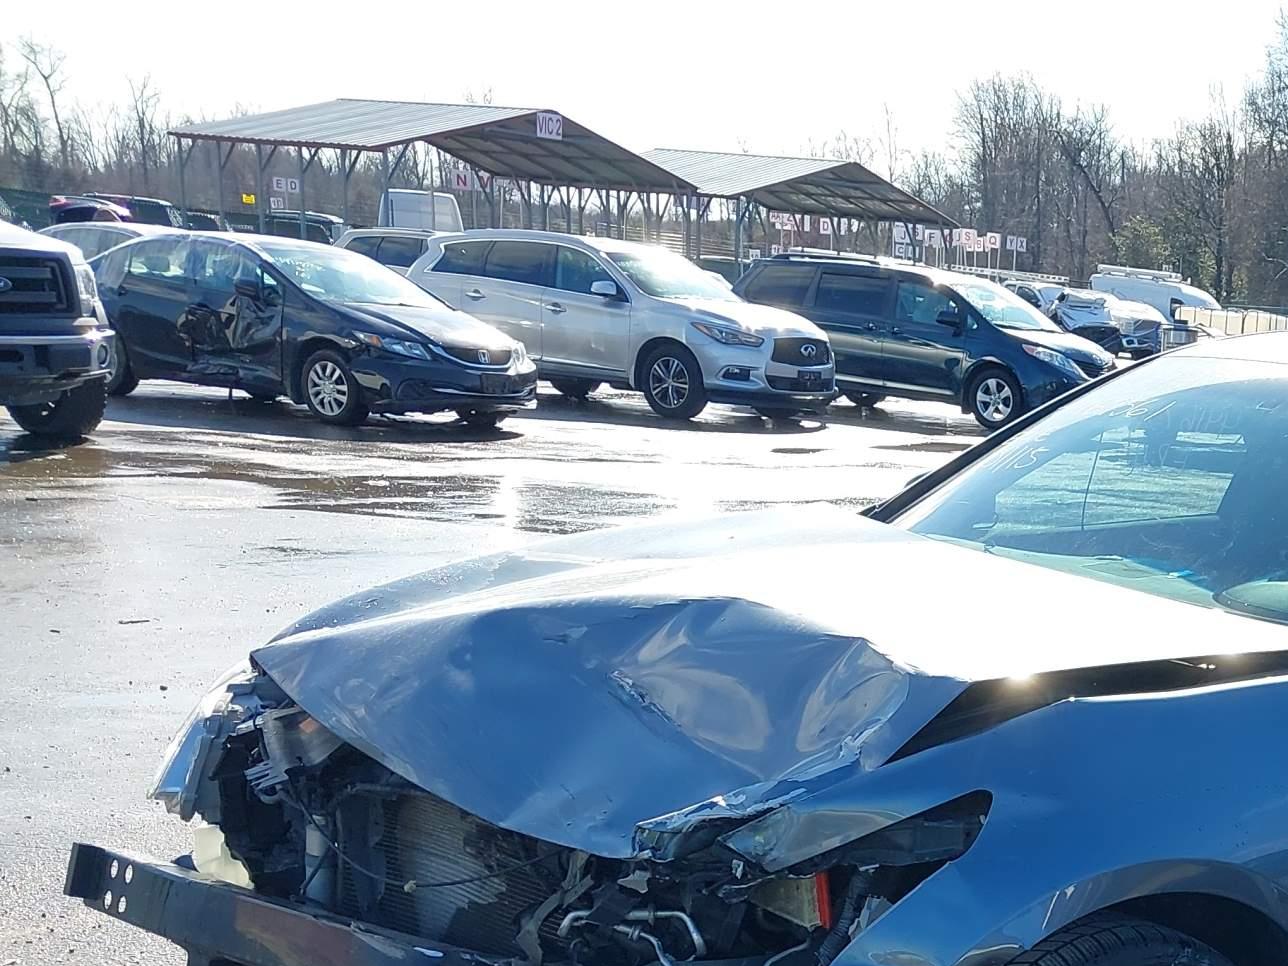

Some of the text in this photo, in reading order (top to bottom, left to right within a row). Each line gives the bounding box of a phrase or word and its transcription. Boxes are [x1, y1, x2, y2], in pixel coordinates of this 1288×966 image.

[537, 115, 562, 136] VIC 2
[456, 173, 467, 187] N
[988, 235, 997, 246] Q
